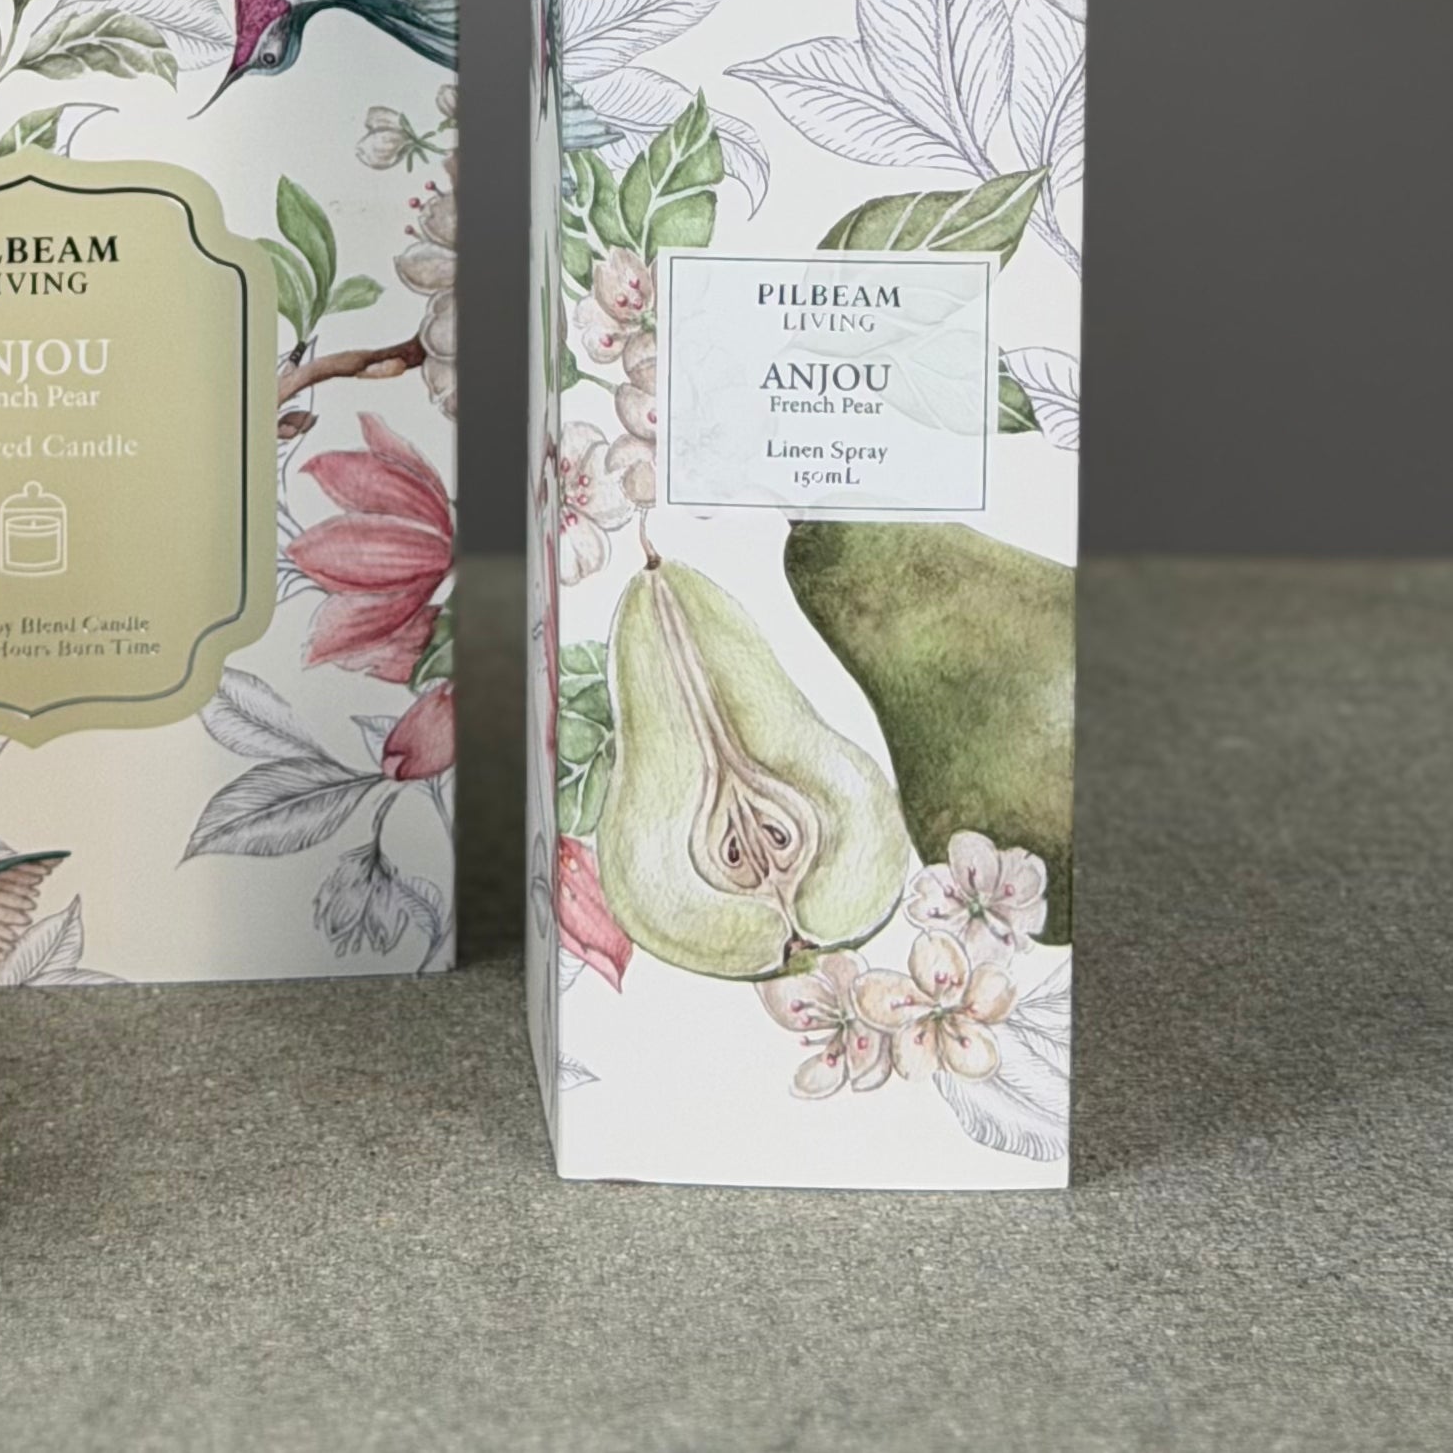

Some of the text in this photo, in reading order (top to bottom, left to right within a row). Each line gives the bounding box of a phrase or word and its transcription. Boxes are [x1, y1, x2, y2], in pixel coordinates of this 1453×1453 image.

[757, 283, 901, 307] PILBEAM
[782, 312, 876, 332] LIVING
[759, 362, 892, 396] ANJOU
[47, 386, 101, 407] Pear
[769, 396, 883, 414] French Pear
[42, 434, 138, 457] Candle
[766, 439, 888, 463] Linen Spray
[793, 466, 861, 487] 150mL
[21, 617, 76, 633] Blend
[83, 616, 150, 633] Candle
[58, 640, 104, 656] Burn
[111, 638, 161, 655] Time
